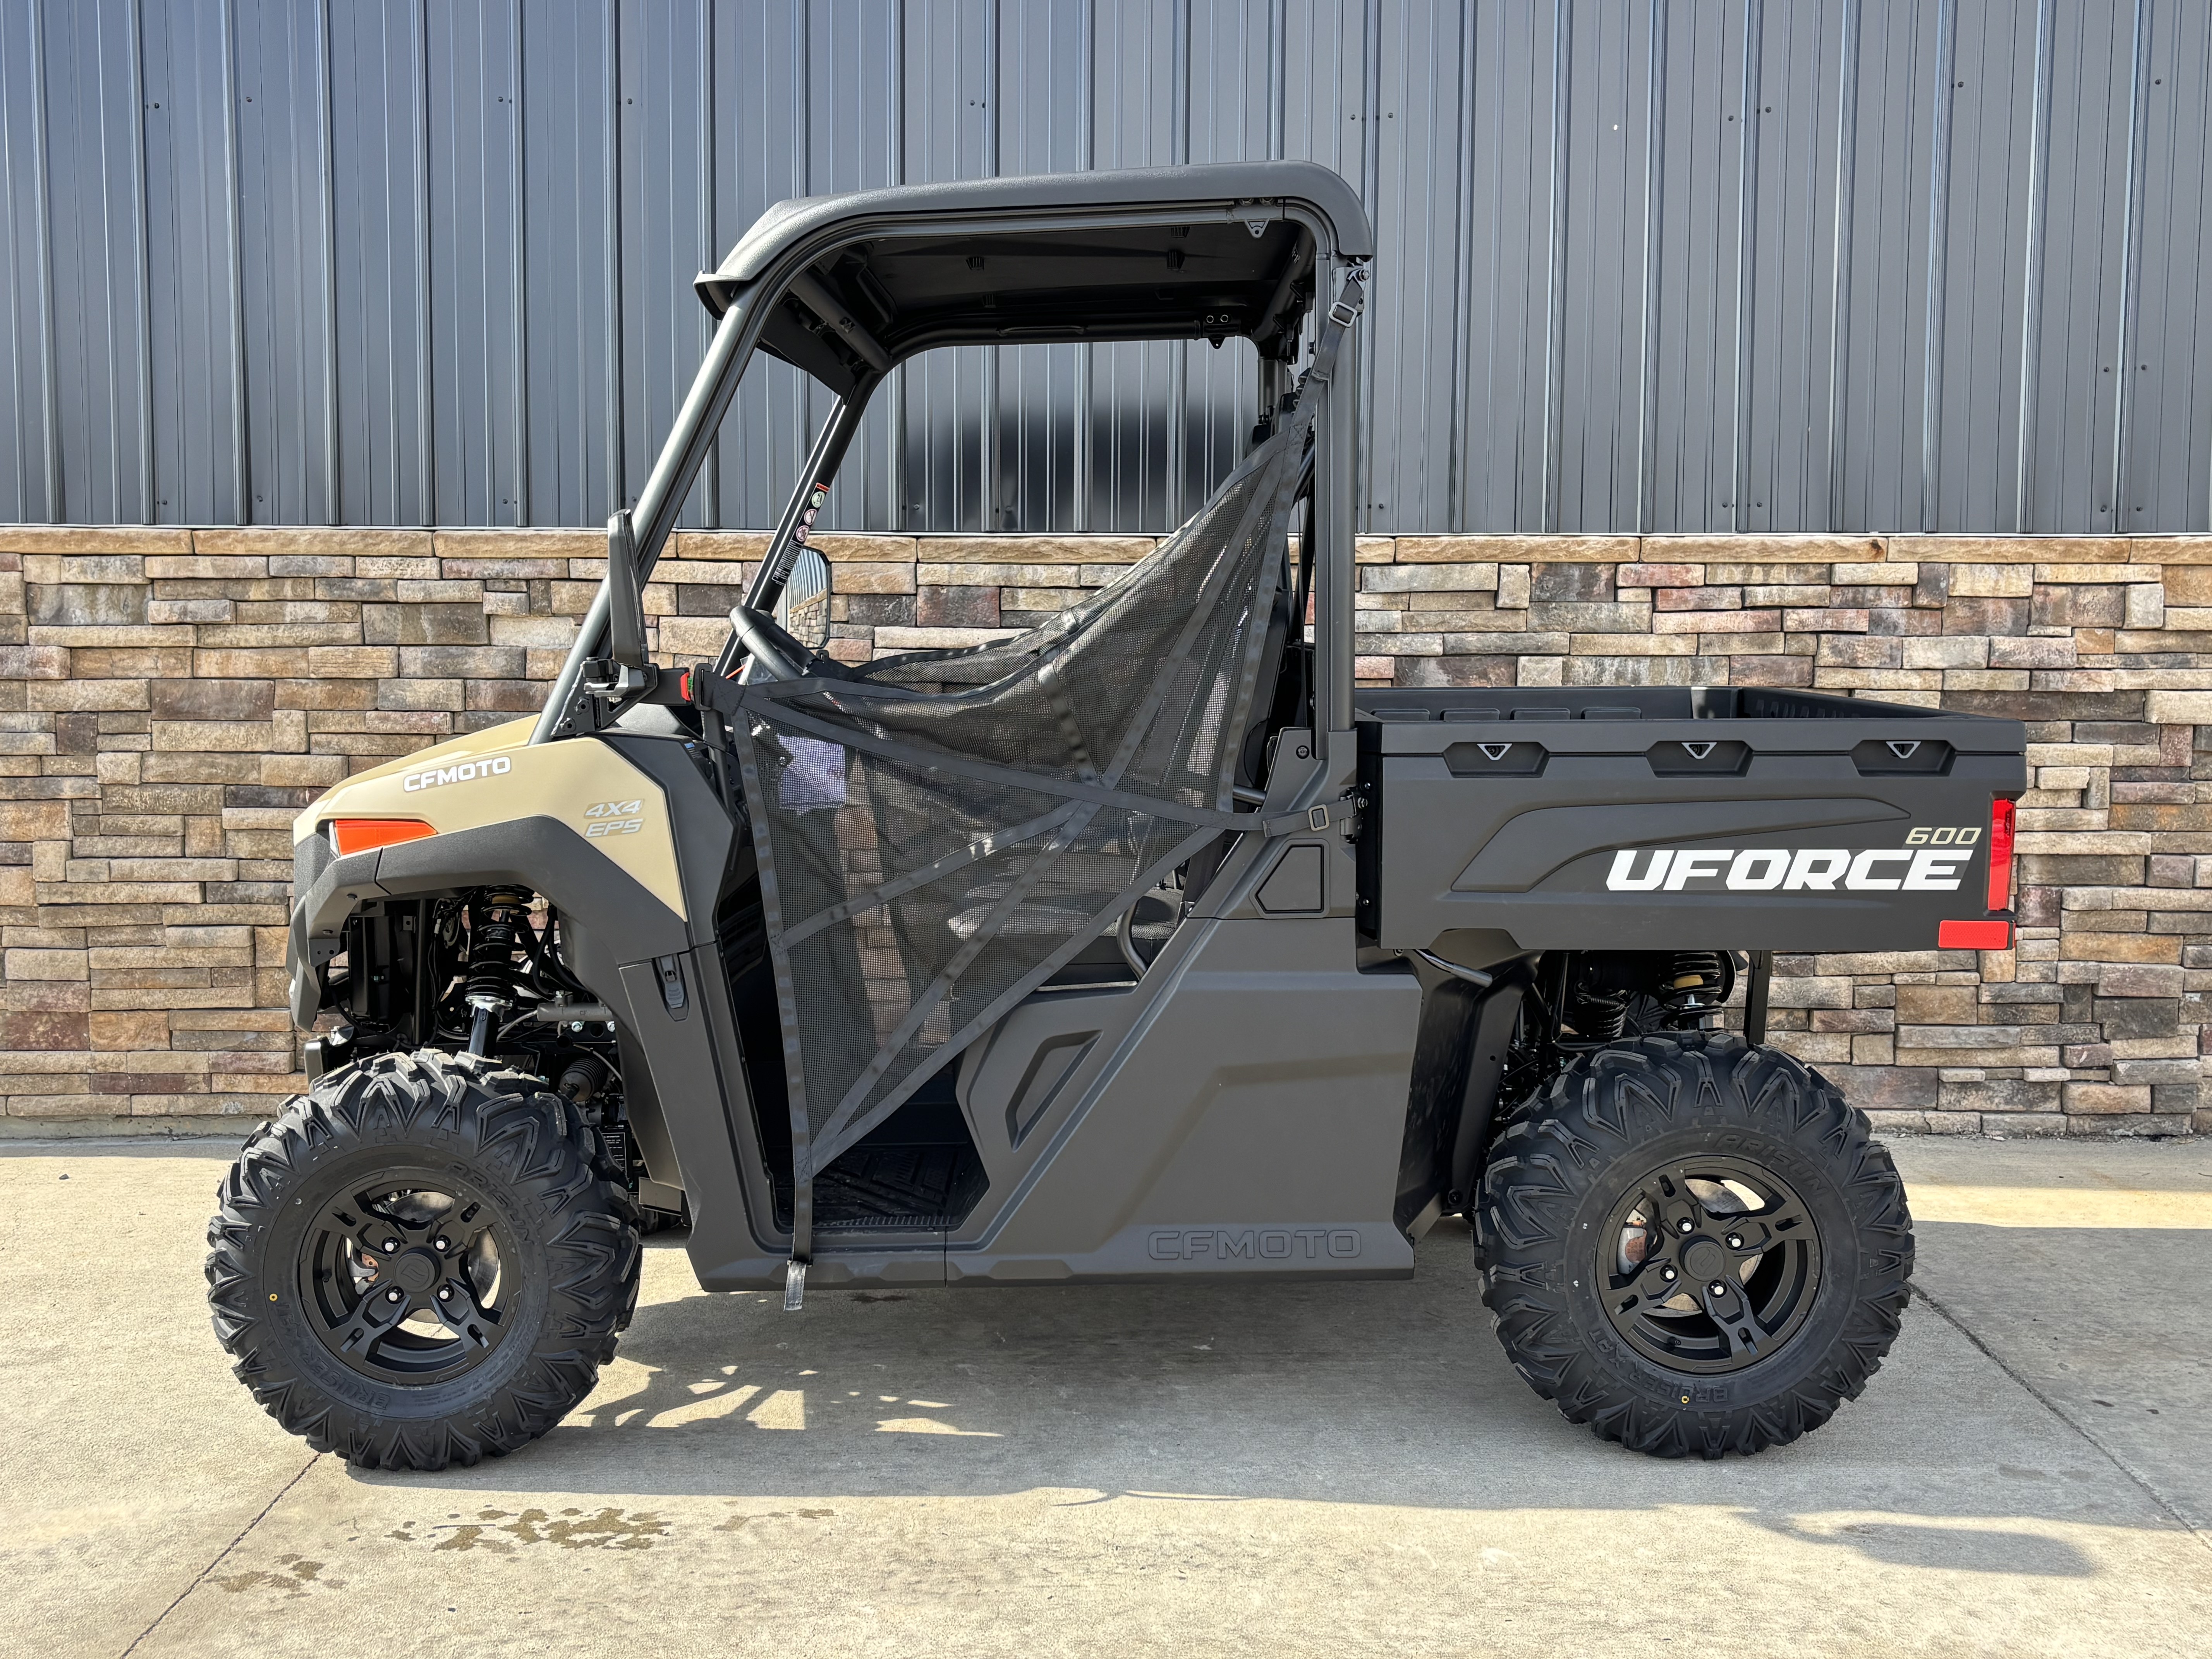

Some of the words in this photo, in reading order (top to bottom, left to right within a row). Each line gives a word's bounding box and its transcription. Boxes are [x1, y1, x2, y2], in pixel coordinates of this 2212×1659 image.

[404, 756, 511, 792] CFMOTO
[585, 800, 642, 817] 4X4
[585, 818, 643, 837] EPS
[1905, 827, 1982, 845] 600
[1606, 849, 1973, 891] UFORCE
[1714, 1133, 1830, 1197] ARISUN
[1148, 1230, 1362, 1260] CFMOTO
